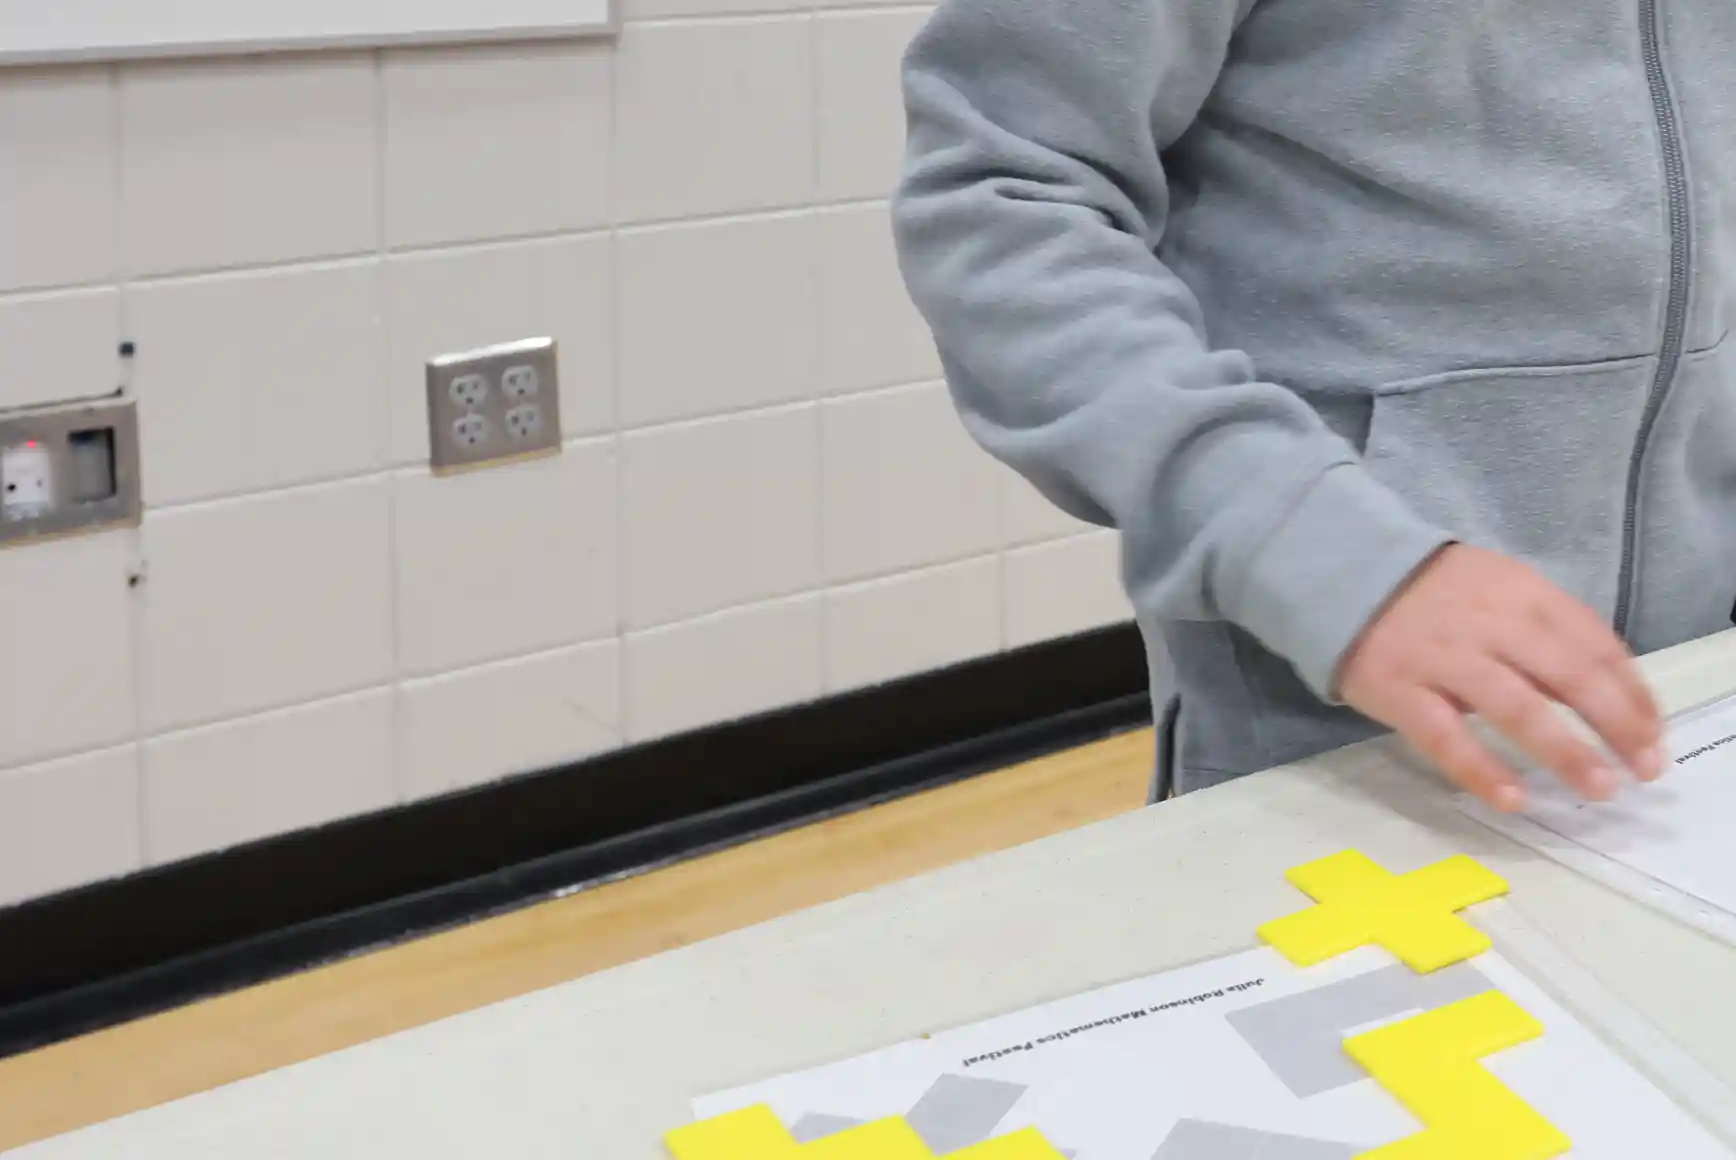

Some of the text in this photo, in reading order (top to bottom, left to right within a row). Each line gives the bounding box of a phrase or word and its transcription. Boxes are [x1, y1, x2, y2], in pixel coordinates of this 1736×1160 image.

[963, 978, 1264, 1066] Julia Robinson Mathematics Festival
